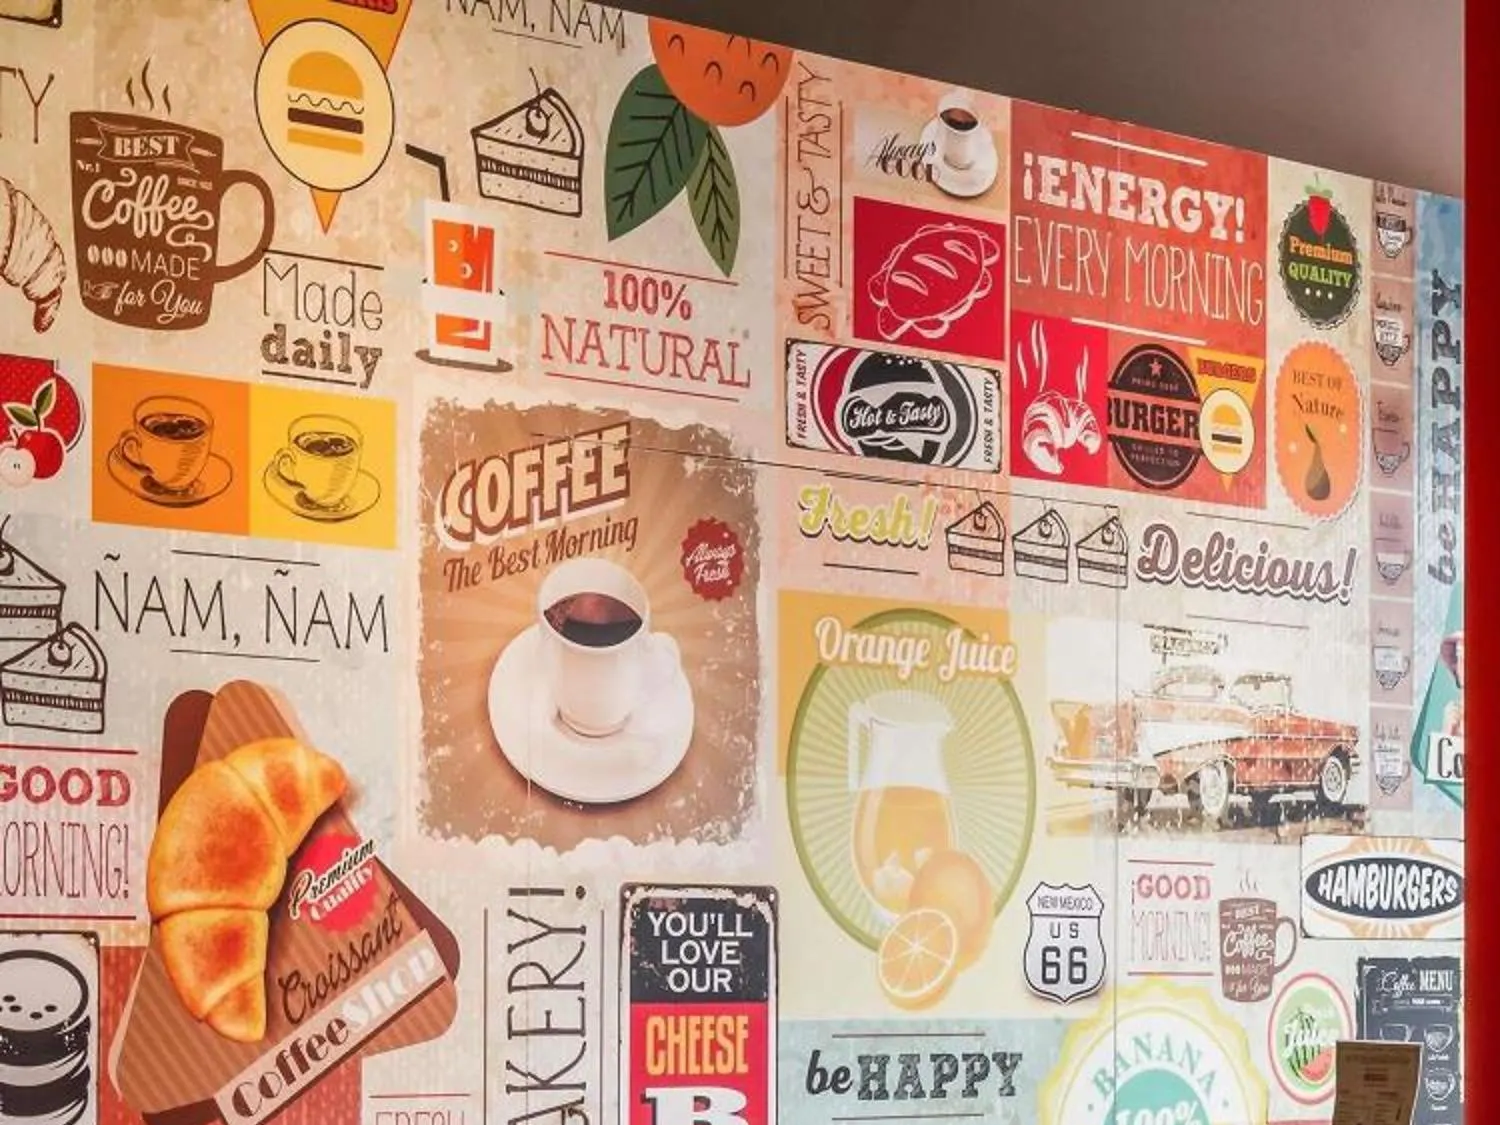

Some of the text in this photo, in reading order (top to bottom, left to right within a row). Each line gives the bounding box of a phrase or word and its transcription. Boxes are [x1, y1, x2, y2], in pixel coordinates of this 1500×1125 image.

[796, 60, 833, 163] TASTY
[113, 134, 181, 160] BEST
[81, 167, 215, 263] Coffee
[797, 167, 830, 215] &
[1023, 151, 1245, 244] ¡ENERGY!
[131, 253, 201, 281] MADE
[795, 214, 834, 331] SWEET
[1014, 215, 1264, 326] EVERY MORNING
[1287, 261, 1353, 290] QUALITY
[1288, 235, 1353, 266] Premium
[114, 279, 205, 325] for You
[262, 256, 384, 332] Made
[602, 270, 693, 321] 100%
[260, 323, 384, 389] daily
[540, 313, 751, 389] NATURAL
[1293, 369, 1344, 391] BEST OF
[849, 405, 882, 429] Hot
[899, 399, 945, 426] Tasty
[1292, 393, 1345, 419] Nature
[1431, 267, 1461, 514] HAPPY
[438, 421, 632, 548] COFFEE
[798, 484, 938, 550] Fresh!
[443, 514, 640, 593] The Best Morning
[1135, 522, 1358, 605] Delicious!
[95, 552, 389, 653] ÑAM, ÑAM
[815, 616, 1017, 681] Orange Juice
[2, 819, 130, 899] ORNING!
[290, 839, 376, 919] Premium
[1317, 862, 1459, 913] HAMBURGERS
[647, 911, 753, 938] YOU'LL
[1037, 894, 1093, 911] NEW MEXICO
[278, 891, 404, 1025] Croissant
[661, 940, 741, 965] LOVE
[1041, 946, 1087, 985] 66
[1131, 908, 1212, 963] MORNING!
[667, 967, 733, 993] OUR
[1419, 970, 1453, 992] MENU
[231, 1017, 349, 1118] Coffee
[645, 1015, 749, 1076] CHEESE
[857, 1052, 1023, 1100] HAPPY
[1092, 1031, 1217, 1101] BANANA
